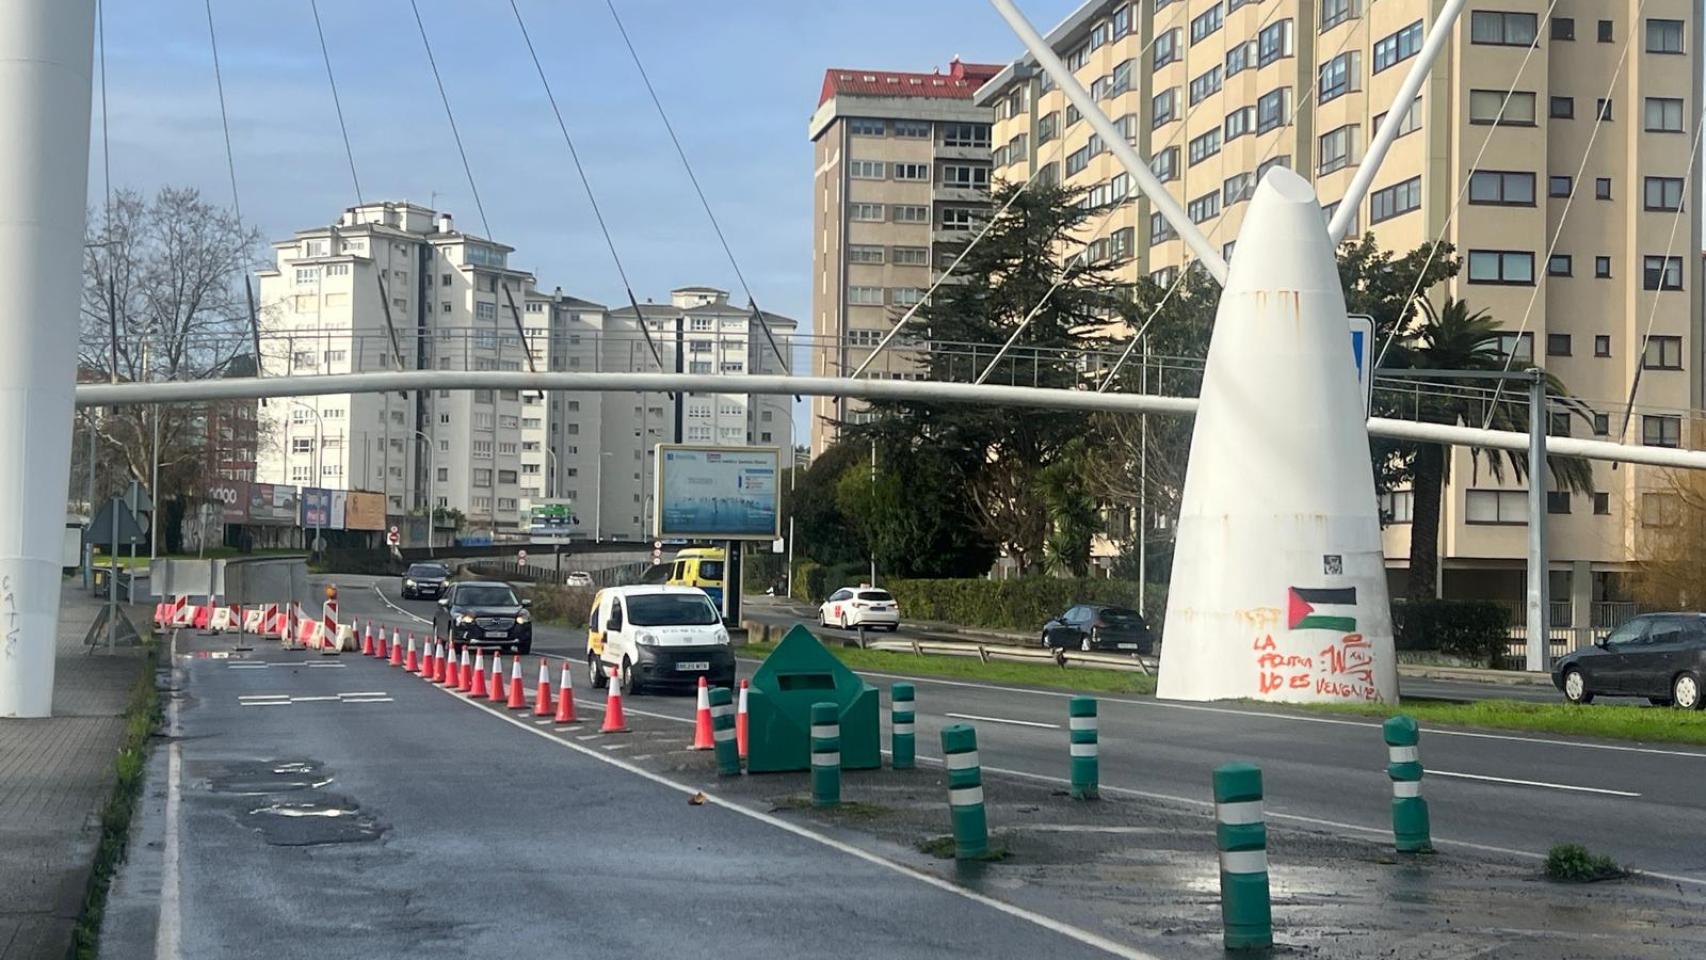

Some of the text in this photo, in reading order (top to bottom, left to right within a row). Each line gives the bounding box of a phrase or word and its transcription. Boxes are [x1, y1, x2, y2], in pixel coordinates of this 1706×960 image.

[1253, 634, 1276, 650] LA
[1259, 672, 1283, 694] NO
[1289, 674, 1311, 688] ES
